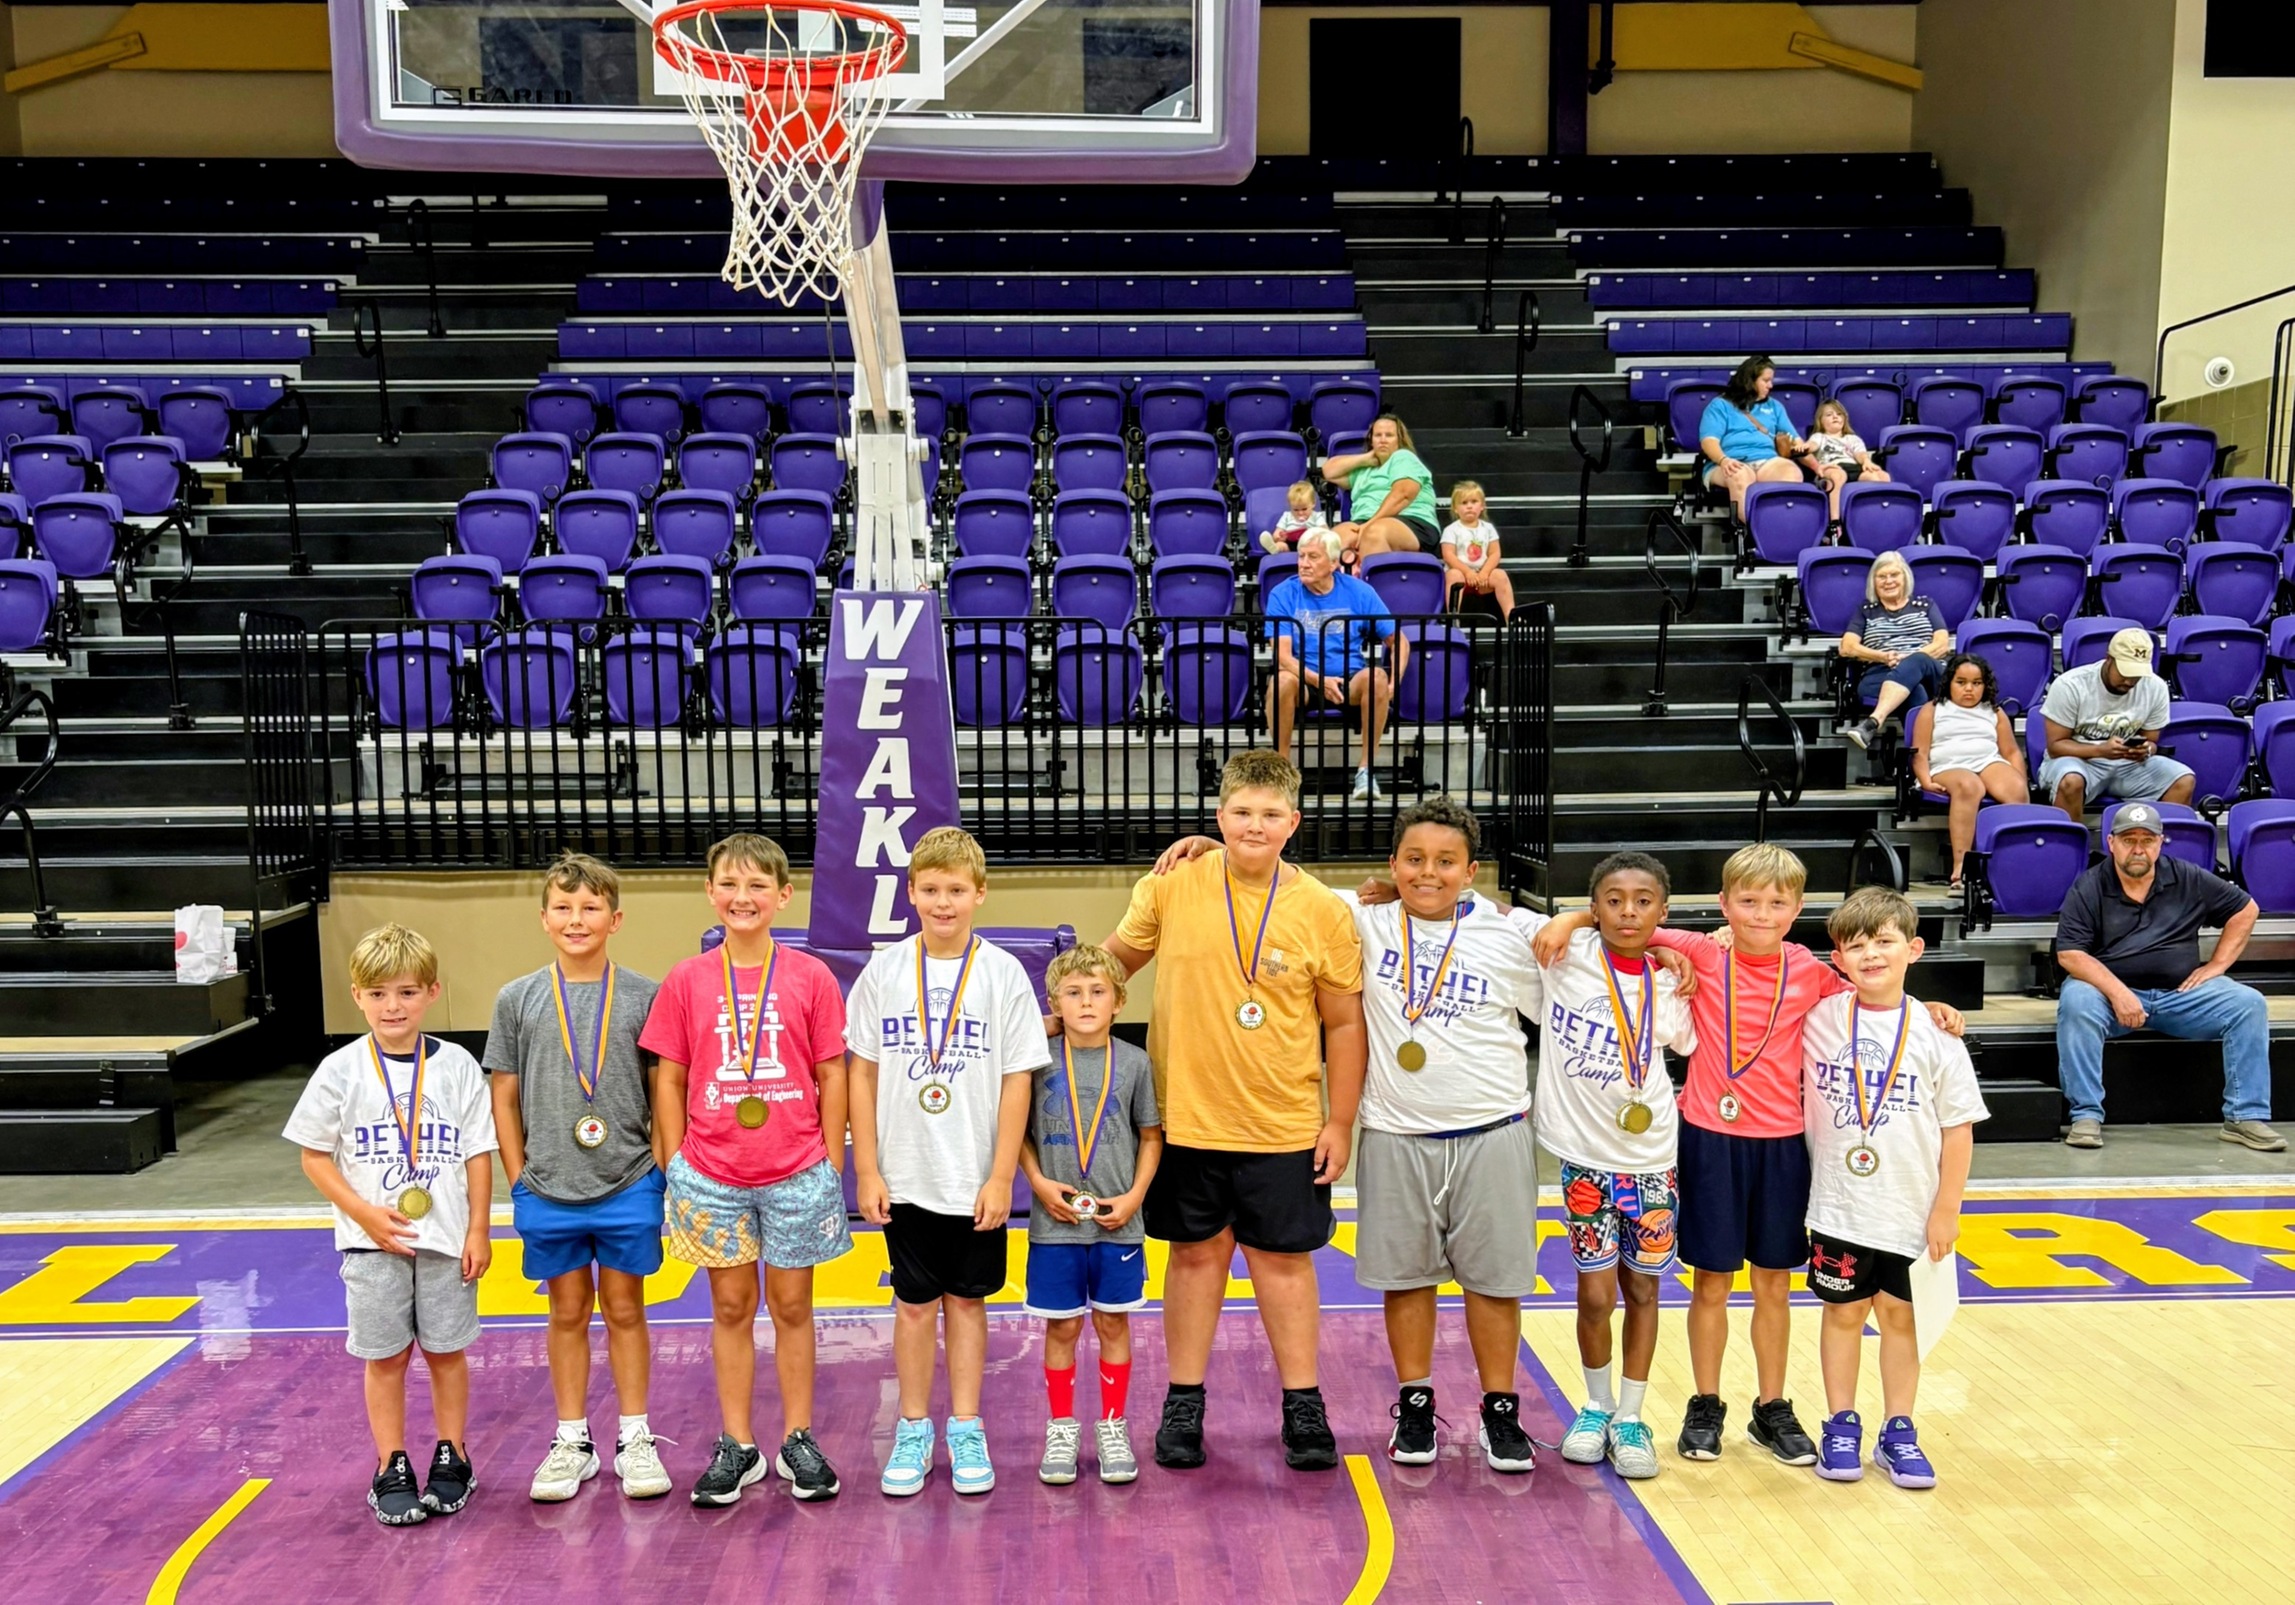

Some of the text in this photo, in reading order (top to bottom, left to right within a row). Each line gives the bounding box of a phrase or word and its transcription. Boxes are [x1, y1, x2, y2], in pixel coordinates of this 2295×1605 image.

[840, 598, 927, 950] WEAKL
[1550, 1001, 1634, 1060] BETH
[901, 1047, 982, 1059] BASKBALL
[1558, 1038, 1624, 1067] BASKETBA
[908, 1055, 966, 1083] Camp
[1564, 1056, 1622, 1091] Camp
[752, 1082, 794, 1091] UNIVERSITY
[771, 1088, 804, 1103] Engineering
[1826, 1094, 1906, 1112] BASKALL
[1043, 1133, 1120, 1146] ARMUR
[370, 1155, 453, 1165] BASKTBALL
[383, 1163, 440, 1191] Camp
[1814, 1268, 1850, 1286] UNDER
